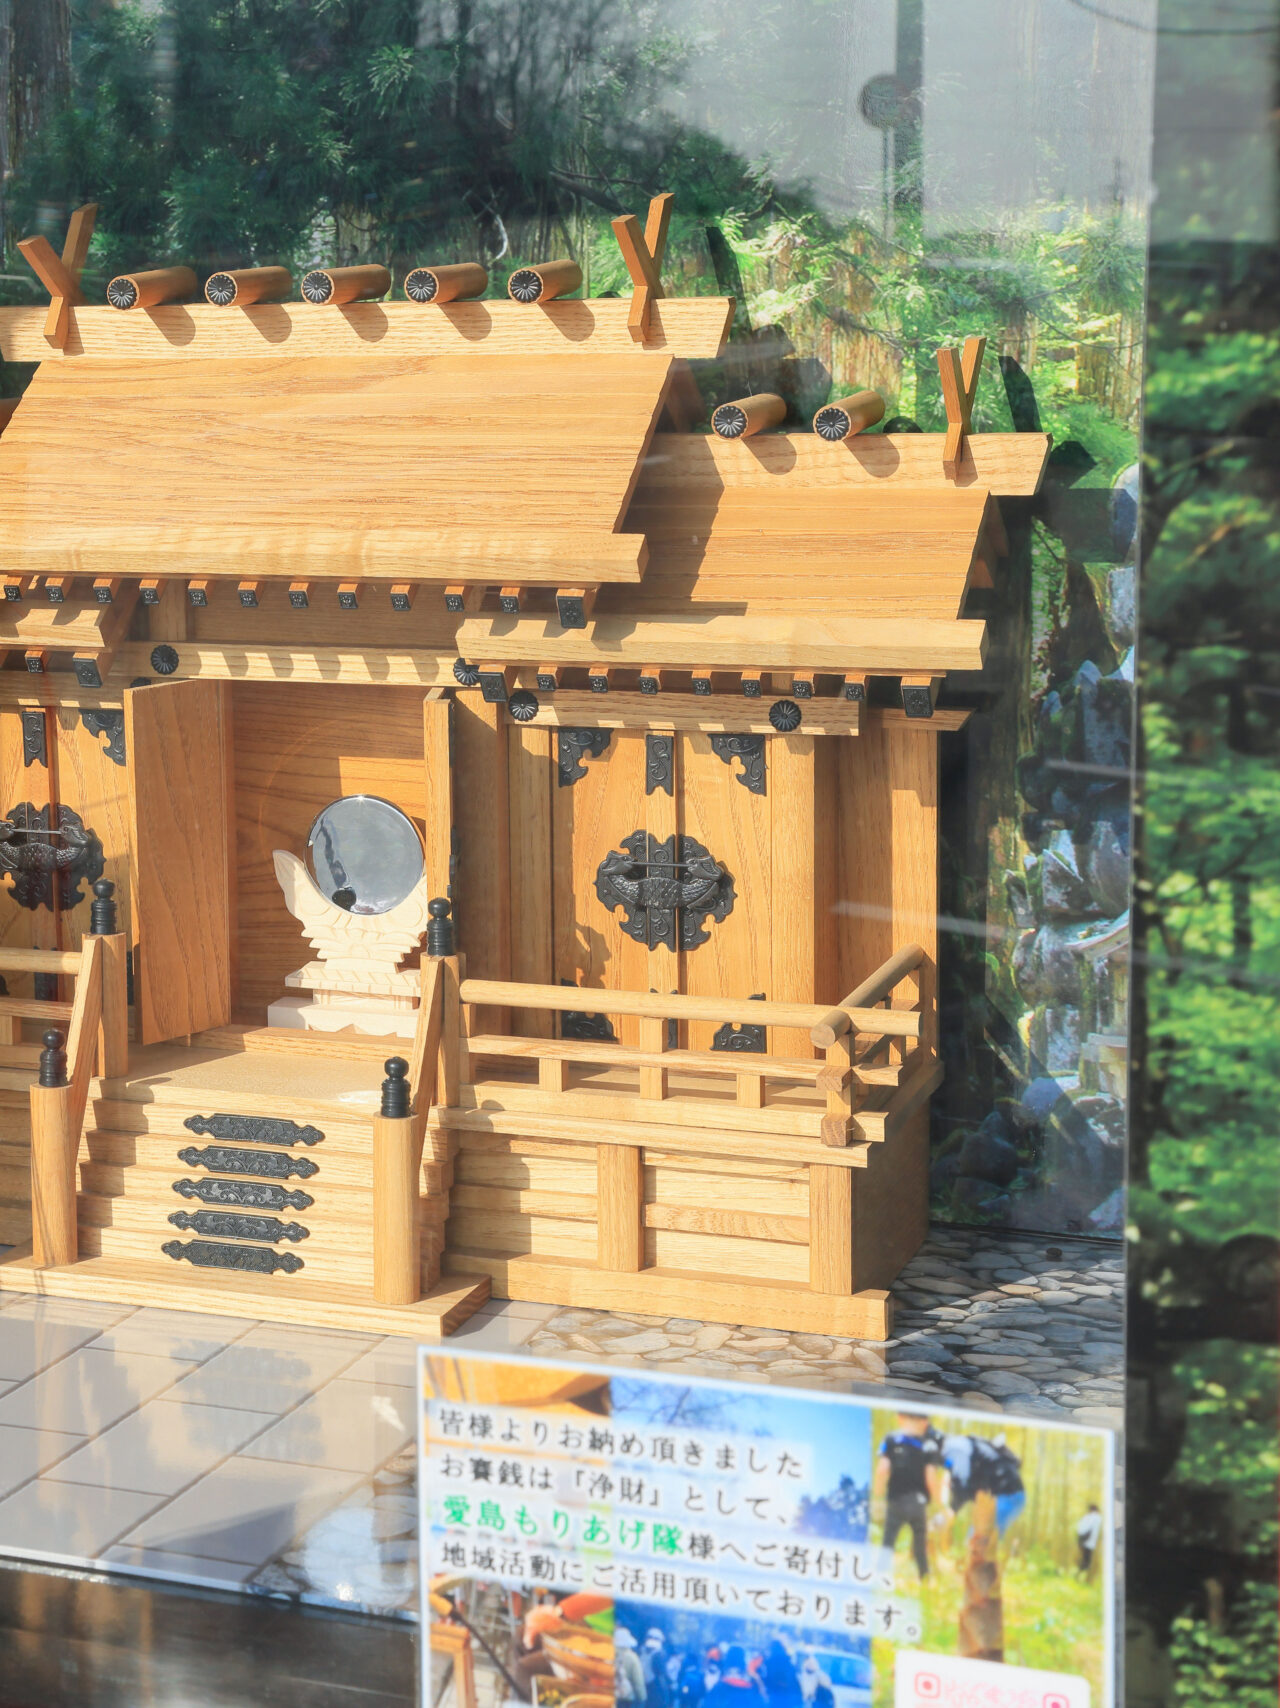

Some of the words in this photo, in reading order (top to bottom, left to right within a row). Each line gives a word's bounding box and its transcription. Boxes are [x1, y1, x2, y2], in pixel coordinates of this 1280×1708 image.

[440, 1408, 802, 1479] 皆様よりお納め頂きました
[442, 1494, 895, 1587] 愛島もりあげ隊様へご寄付し、
[441, 1541, 920, 1637] 地域活動にご活用頂いております。
